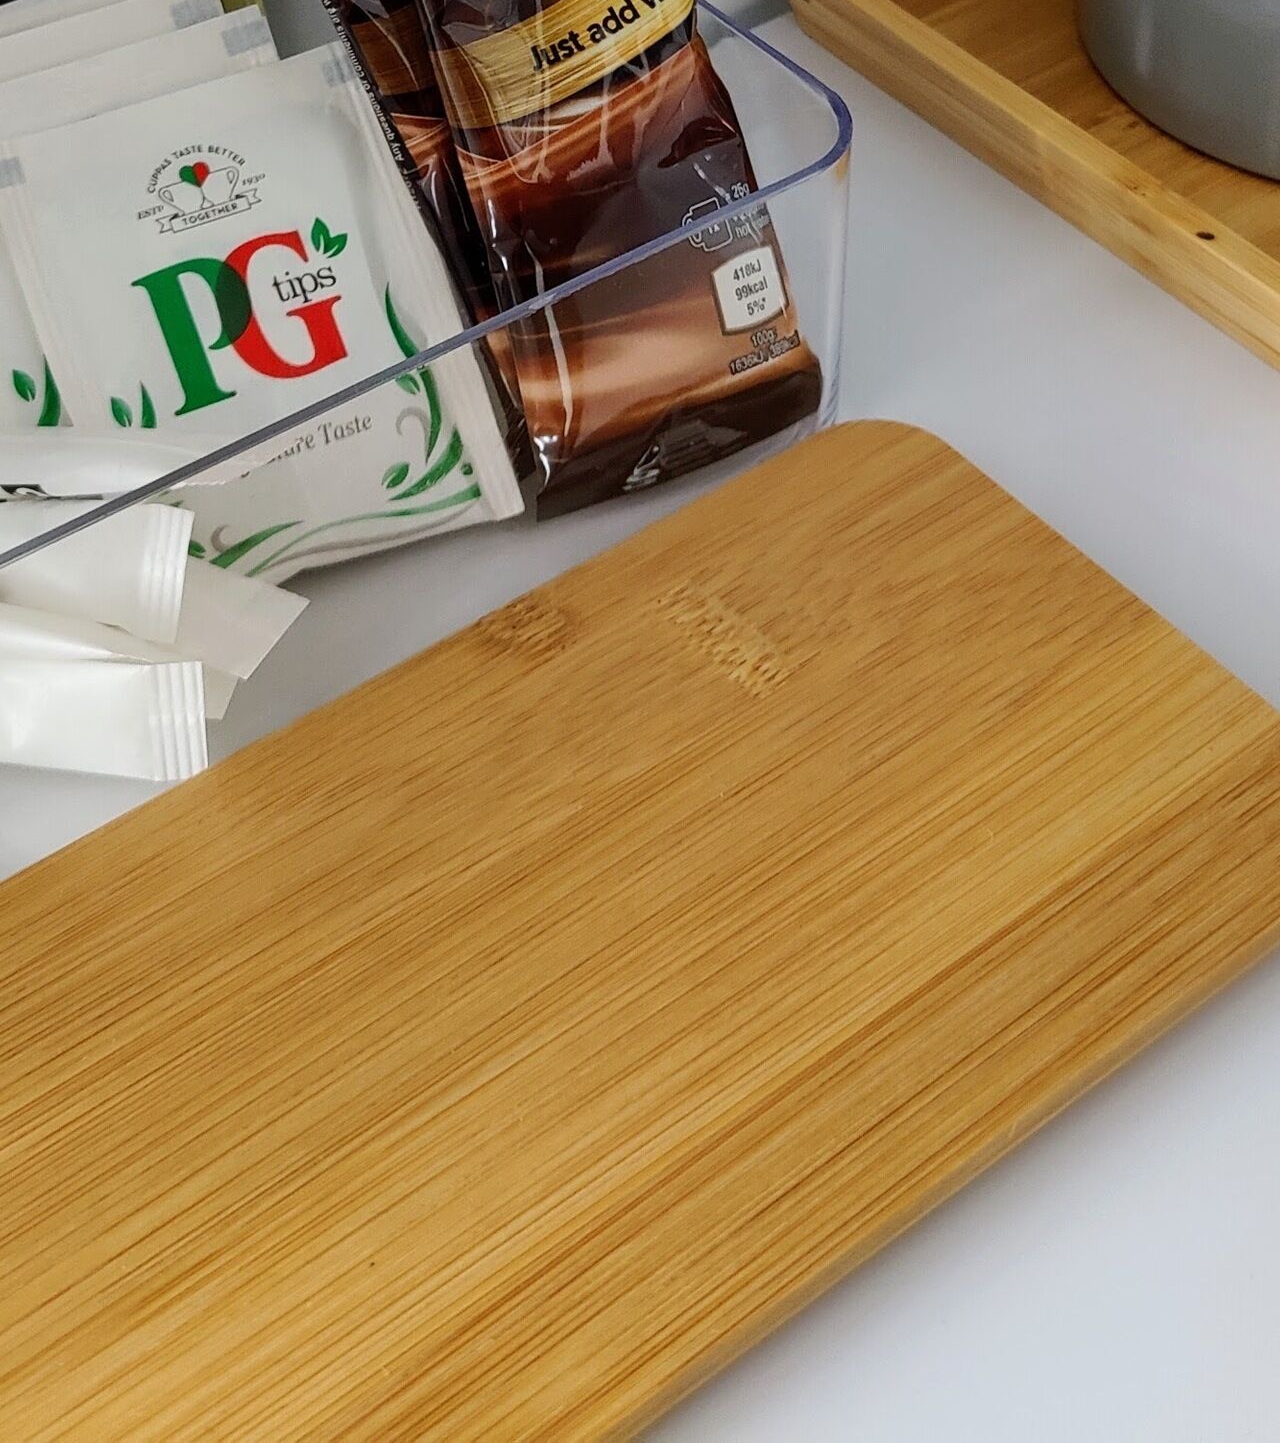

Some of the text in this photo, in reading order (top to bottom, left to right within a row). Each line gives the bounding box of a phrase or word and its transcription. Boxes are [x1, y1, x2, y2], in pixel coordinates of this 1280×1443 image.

[531, 33, 587, 71] Just
[586, 4, 639, 43] add
[389, 141, 407, 163] Any
[147, 144, 246, 194] CUPPAS TASTE BETTER
[182, 203, 237, 225] TOGETHER
[272, 266, 337, 303] tips
[733, 259, 762, 282] 418kJ
[735, 277, 769, 301] 99kcal
[131, 230, 349, 416] PG
[317, 415, 372, 445] Taste
